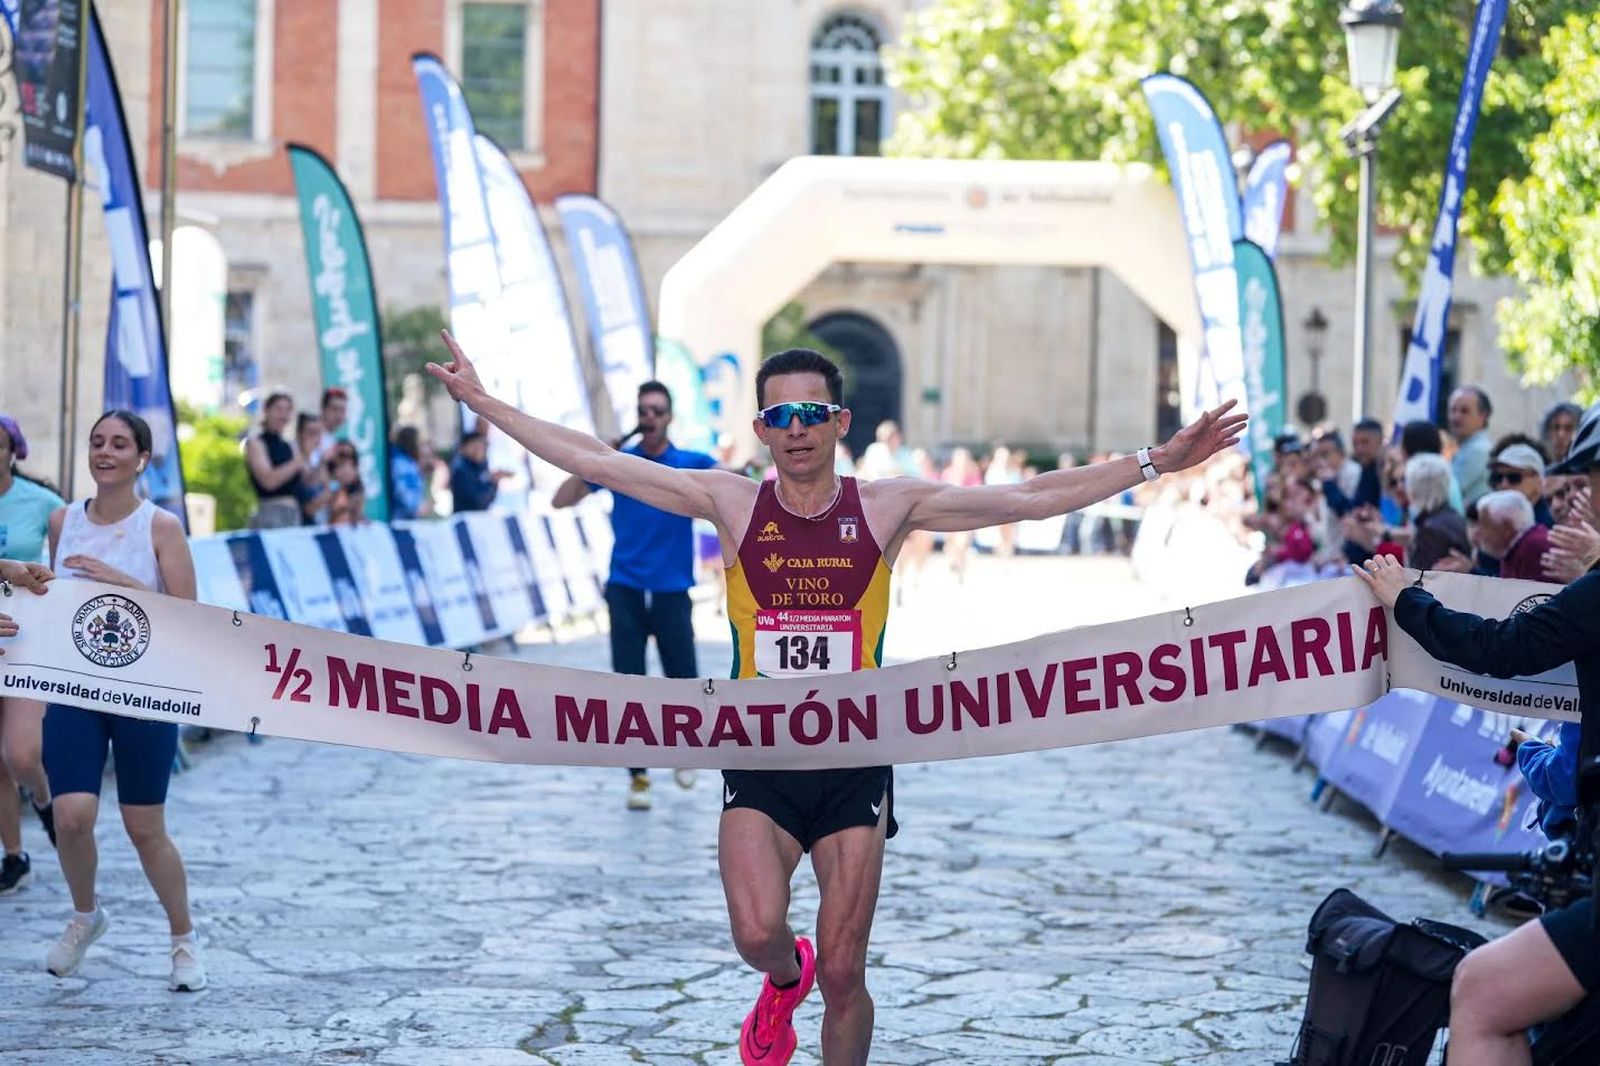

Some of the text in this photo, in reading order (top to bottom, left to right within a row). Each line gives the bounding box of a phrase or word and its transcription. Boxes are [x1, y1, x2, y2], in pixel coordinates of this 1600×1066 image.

[787, 557, 853, 568] CAJA RURAL
[786, 577, 830, 590] VINO
[771, 592, 844, 606] DE TORO
[758, 615, 775, 626] UVa
[800, 614, 821, 622] MEDIA
[821, 613, 852, 622] MARATÓN
[775, 635, 830, 670] 134
[326, 655, 532, 740] MEDIA
[555, 689, 877, 746] MARATÓN
[906, 605, 1388, 734] UNIVERSITARIA
[4, 674, 201, 716] Universidad de Valladolid
[1440, 676, 1532, 707] Universidad
